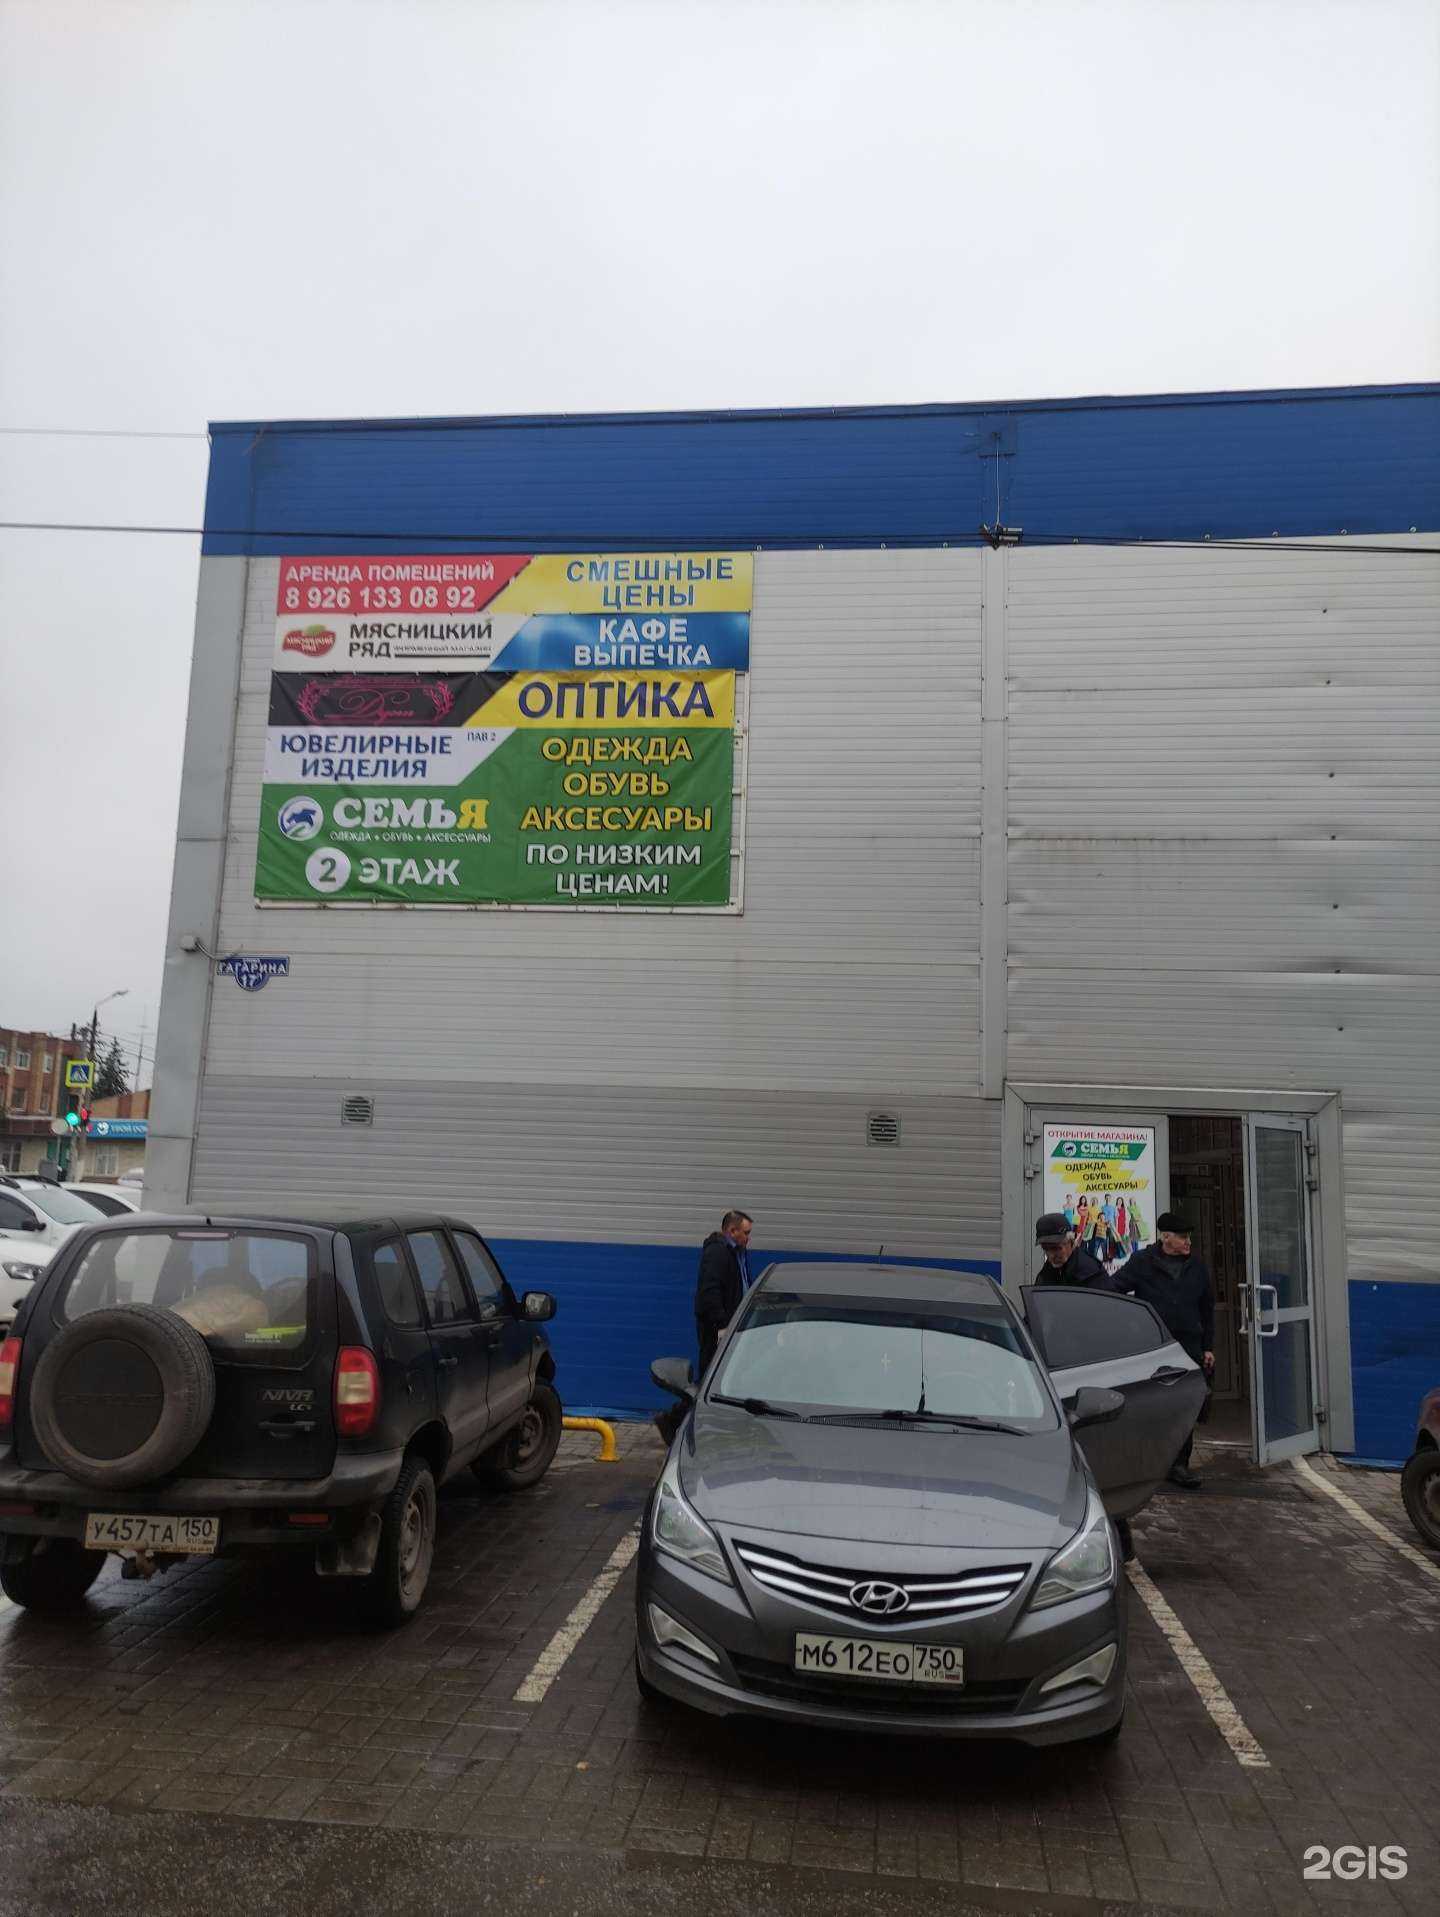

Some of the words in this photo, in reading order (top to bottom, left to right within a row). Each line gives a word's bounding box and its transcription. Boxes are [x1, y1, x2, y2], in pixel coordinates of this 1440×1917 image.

[285, 565, 362, 583] АРЕНДА
[368, 560, 495, 583] ПОМЕЩЕНИЙ
[566, 558, 734, 582] СМЕШНЫЕ
[285, 586, 300, 608] 8
[307, 586, 351, 608] 926
[360, 586, 401, 608] 133
[409, 586, 438, 608] 08
[446, 586, 475, 608] 92
[602, 585, 694, 610] ЦЕНЫ
[350, 618, 492, 639] МЯСНИЦКИЙ
[600, 618, 688, 643] КАФЕ
[349, 642, 391, 658] РЯД
[574, 645, 712, 666] ВЫПЕЧКА
[518, 681, 715, 719] ОПТИКА
[280, 734, 452, 755] ЮВЕЛИРНЫЕ
[541, 737, 693, 766] ОДЕЖДА
[301, 758, 427, 781] ИЗДЕЛИЯ
[562, 772, 670, 796] ОБУВЬ
[332, 797, 490, 829] СЕМЬЯ
[520, 806, 712, 831] АКСЕСУАРЫ
[329, 831, 372, 842] ОДЕЖДА
[382, 832, 414, 842] ОБУВЬ
[526, 844, 569, 865] ПО
[575, 844, 701, 866] НИЗКИМ
[318, 857, 337, 882] 2
[358, 857, 461, 886] ЭТАЖ
[556, 873, 669, 896] ЦЕНАМ!
[217, 961, 286, 974] ГАГАРИНА
[1048, 1130, 1095, 1139] ОТКРЫТИЕ
[1096, 1132, 1148, 1141] МАГАЗИНА!
[1080, 1142, 1129, 1155] СЕМЬЯ
[1065, 1162, 1107, 1172] ОДЕЖДА
[1082, 1173, 1112, 1181] ОБУВЬ
[1085, 1181, 1138, 1192] АКСЕСУАРЫ
[93, 1517, 174, 1543] У457ТА
[181, 1519, 213, 1537] 150
[803, 1640, 910, 1675] М612ЕО
[915, 1647, 956, 1671] 750
[924, 1670, 945, 1680] RUS
